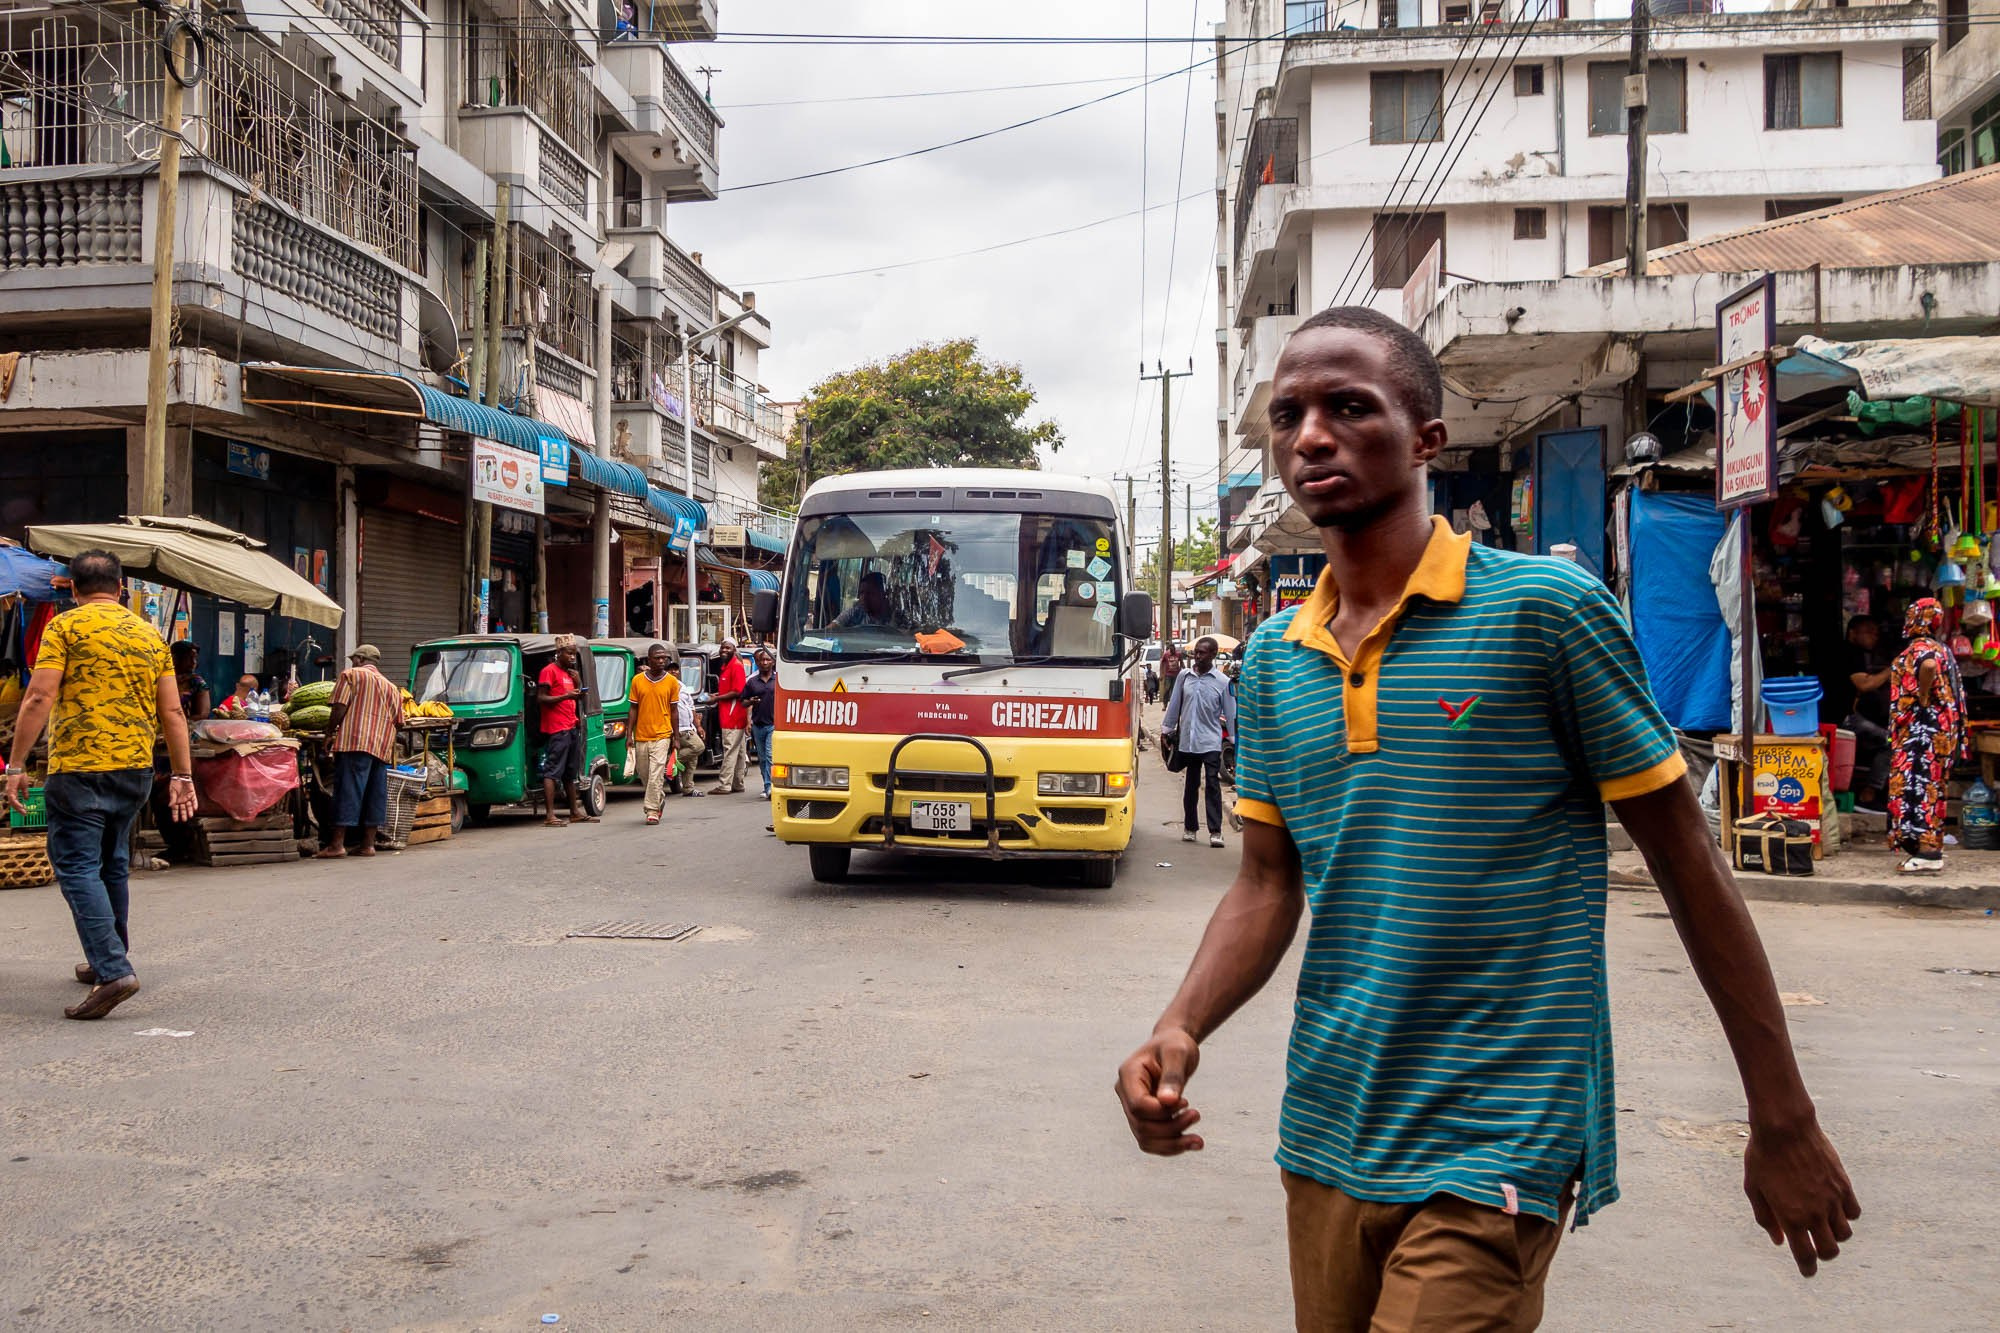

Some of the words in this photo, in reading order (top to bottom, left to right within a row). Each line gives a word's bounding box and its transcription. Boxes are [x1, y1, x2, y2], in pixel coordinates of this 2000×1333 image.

[1729, 301, 1760, 327] TRONIC
[1726, 452, 1763, 476] MKUNGUNI
[1725, 478, 1734, 493] NA
[1735, 470, 1765, 491] SIKUKUU
[1278, 577, 1315, 588] WAKAL
[786, 699, 858, 727] MABIBO
[935, 703, 950, 711] VIA
[991, 701, 1098, 731] GEREZANI
[1757, 747, 1793, 757] 46826
[1775, 768, 1815, 779] 46826
[924, 803, 956, 817] T658
[932, 818, 956, 829] DRC
